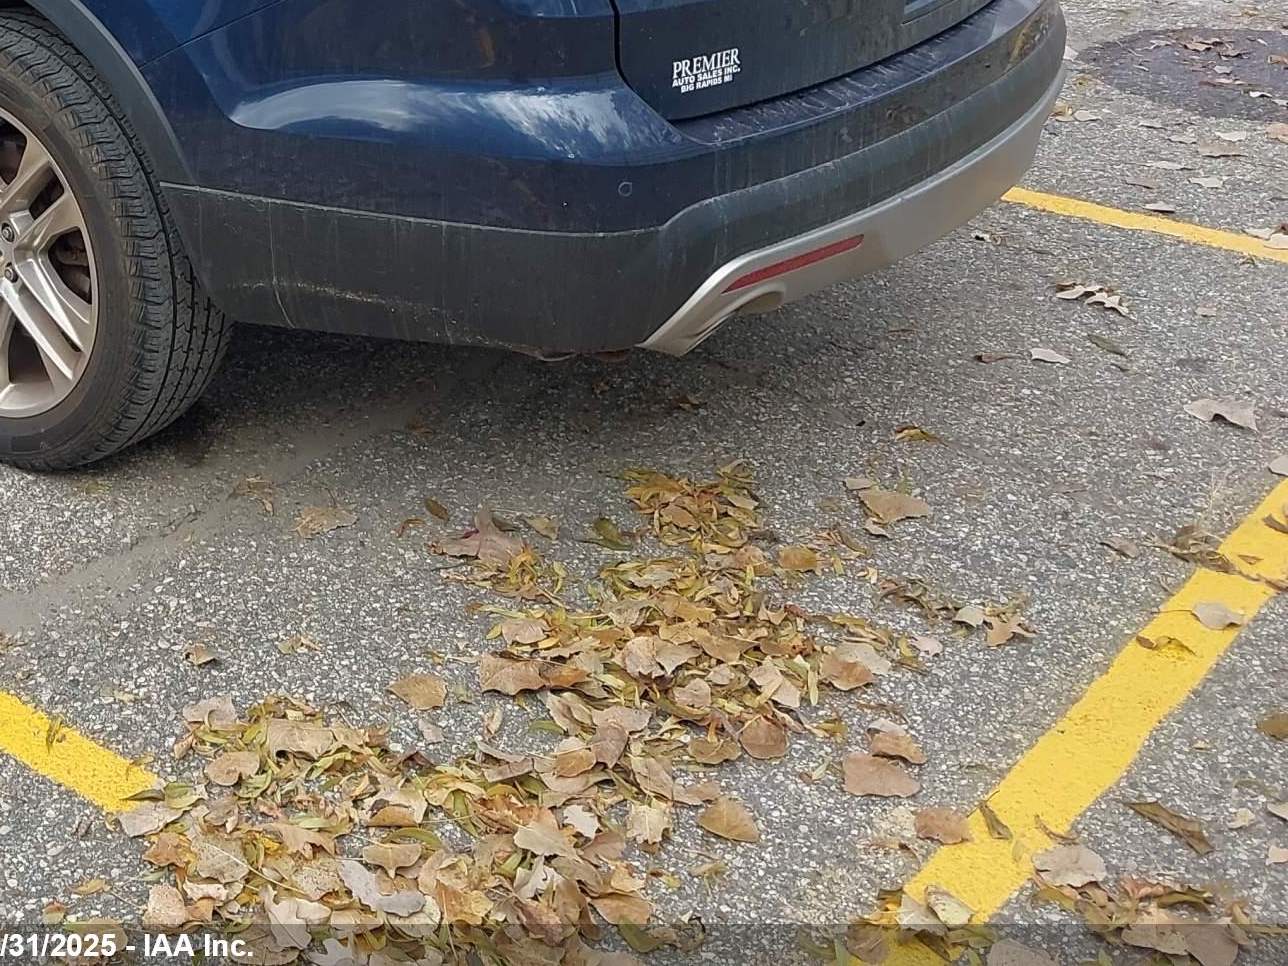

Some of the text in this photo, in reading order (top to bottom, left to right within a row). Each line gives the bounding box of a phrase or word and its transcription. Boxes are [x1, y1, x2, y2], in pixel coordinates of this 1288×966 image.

[672, 47, 741, 80] PREMIER
[672, 64, 741, 88] AUTO SALES INC.
[680, 84, 695, 94] BIG
[695, 77, 723, 90] RAPIDS
